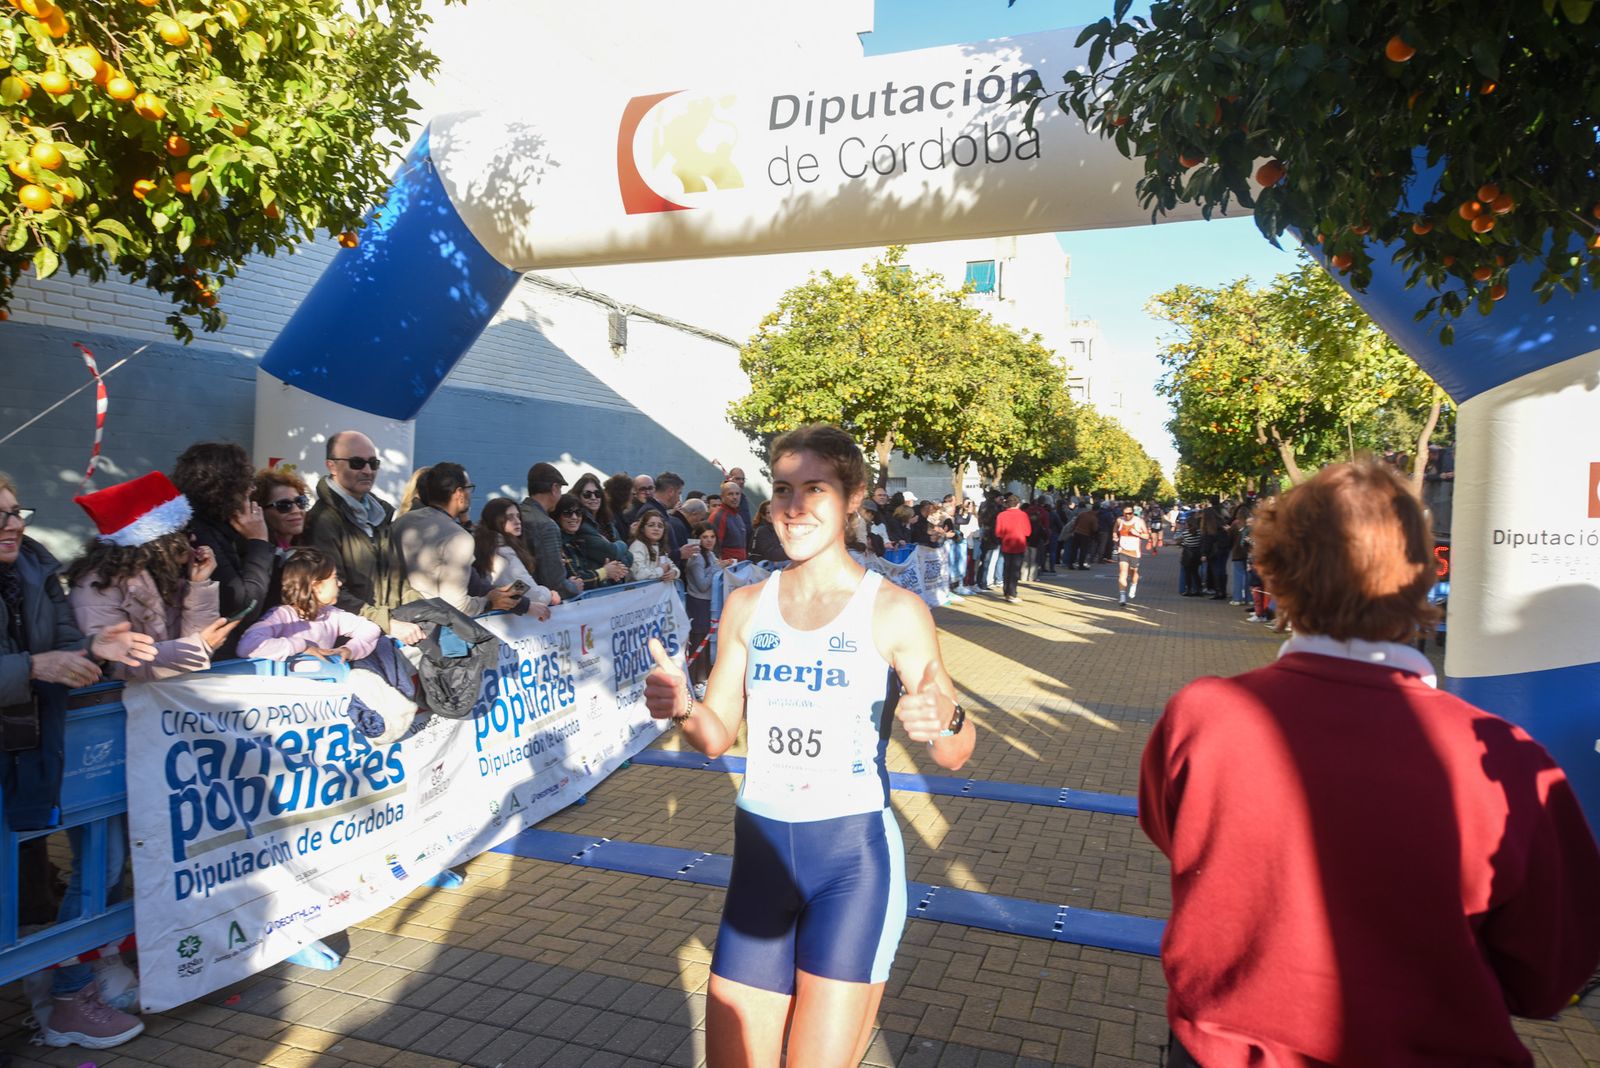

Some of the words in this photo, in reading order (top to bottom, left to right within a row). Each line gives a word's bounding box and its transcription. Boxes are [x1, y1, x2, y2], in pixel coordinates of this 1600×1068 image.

[768, 64, 1040, 135] Diputación
[767, 145, 820, 186] de
[838, 121, 1041, 179] Córdoba
[1493, 529, 1600, 548] Diputació
[480, 651, 560, 701] arreras
[753, 660, 850, 692] nerja
[161, 707, 261, 736] CIRCUITO
[265, 697, 350, 728] PROVINC
[472, 674, 575, 752] populares
[165, 723, 372, 791] carreras
[478, 734, 547, 777] Diputación
[767, 726, 823, 758] 885
[168, 743, 406, 863] populares
[175, 835, 293, 901] Diputación
[297, 828, 322, 856] de
[330, 803, 404, 845] Córdoba
